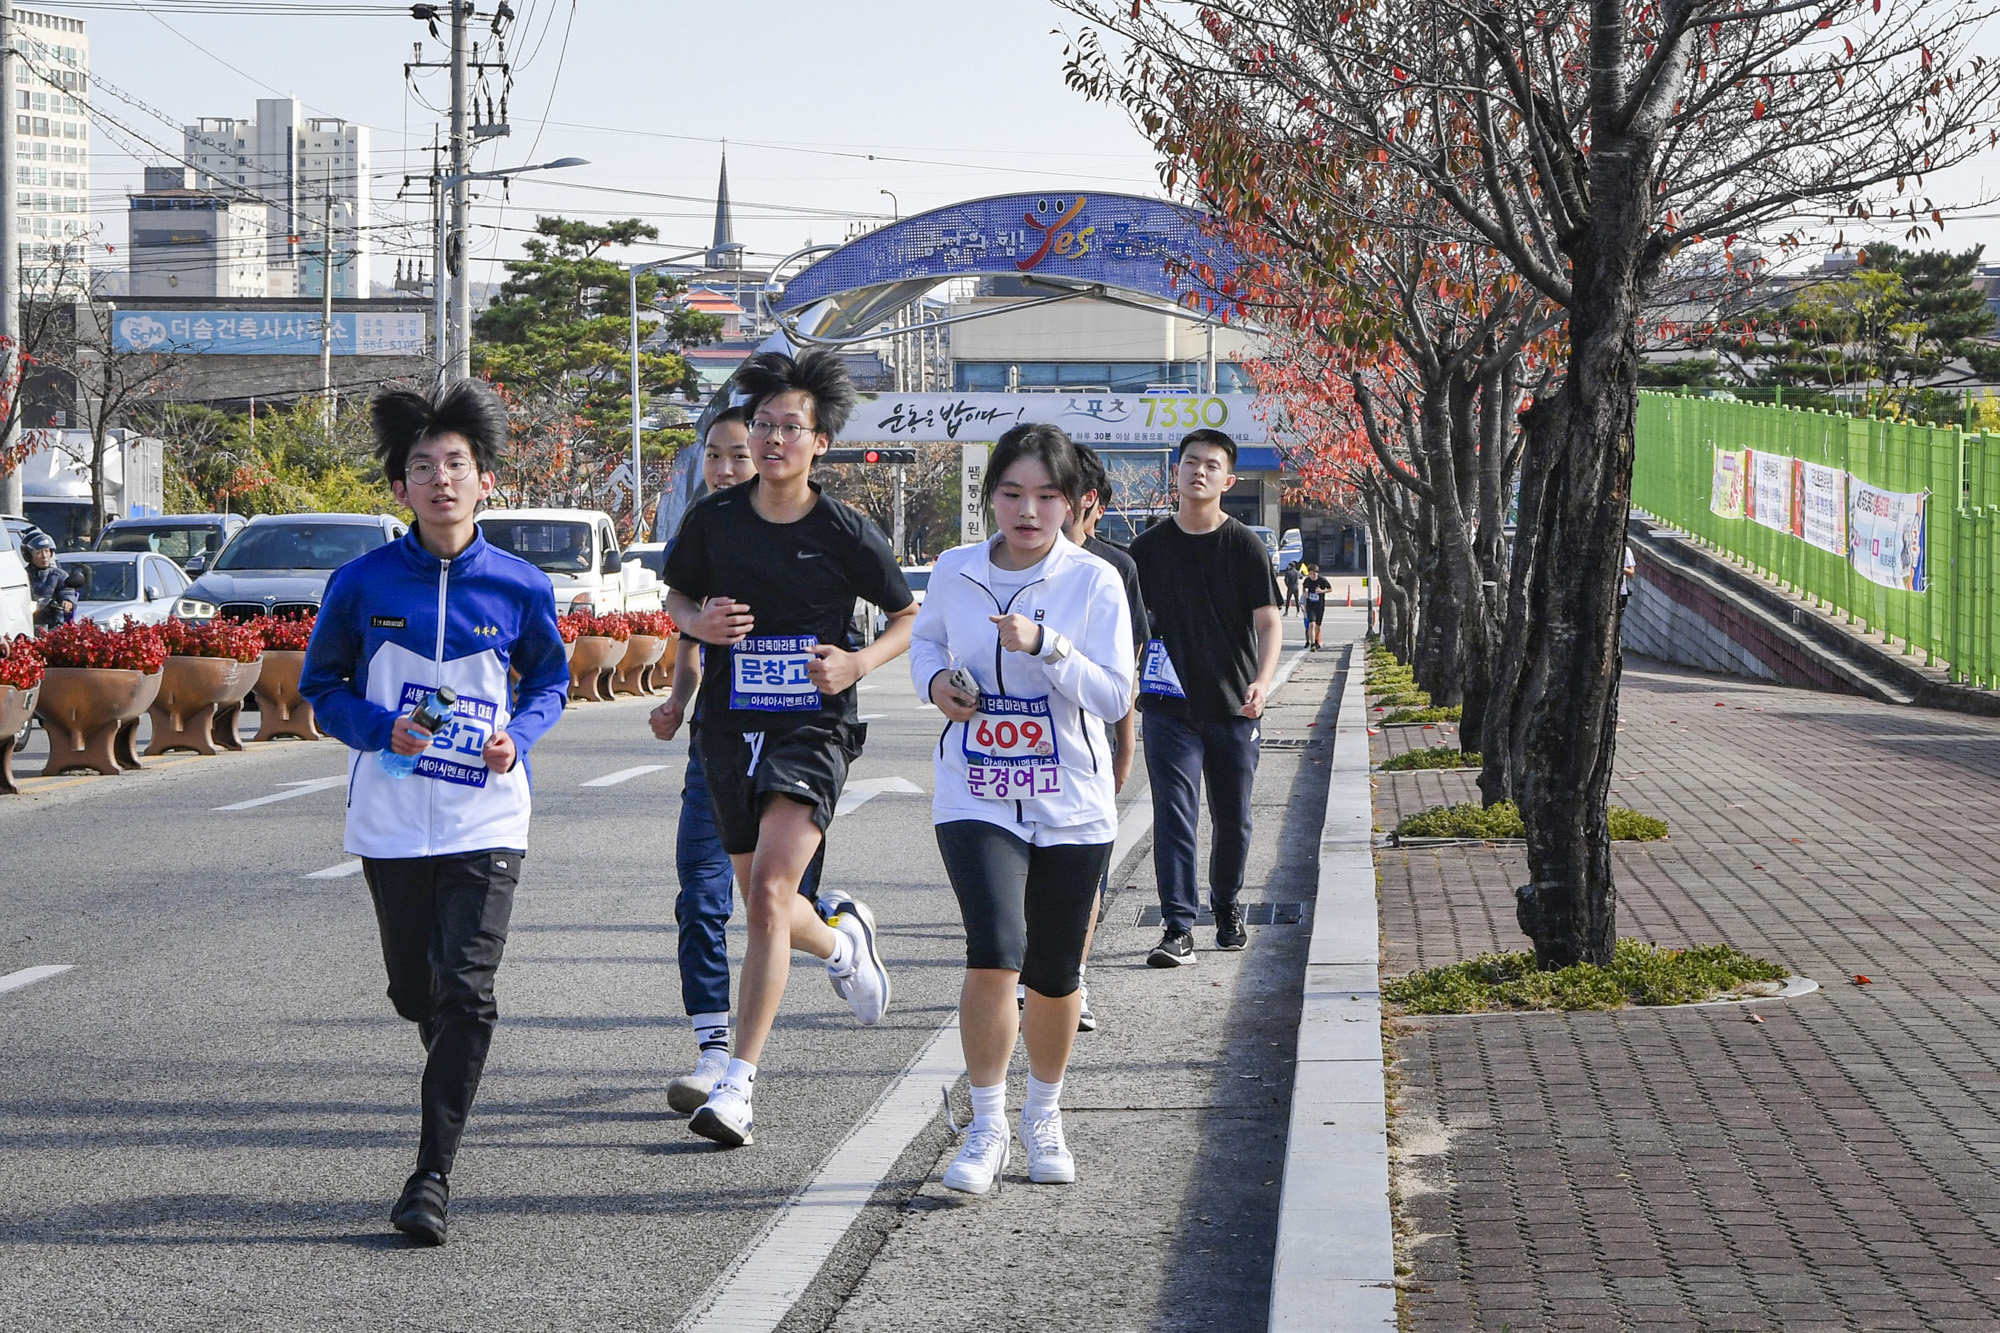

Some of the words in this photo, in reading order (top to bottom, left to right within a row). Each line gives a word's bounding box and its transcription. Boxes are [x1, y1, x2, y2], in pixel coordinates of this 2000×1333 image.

[1015, 196, 1095, 271] Yes
[878, 403, 935, 434] 운동은
[1063, 398, 1128, 417] 스포츠
[1139, 397, 1229, 429] 7330
[1094, 432, 1111, 440] 30분
[1116, 432, 1130, 440] 이상
[757, 639, 797, 652] 단축마라톤
[741, 659, 811, 685] 문창고
[478, 703, 494, 720] 대회
[751, 695, 819, 707] 아세아시멘트(주)
[987, 698, 1029, 713] 단축마라톤
[1030, 700, 1047, 714] 대회
[976, 720, 1043, 749] 609
[418, 759, 485, 784] 세아시멘트(주)
[967, 766, 1061, 798] 문경여고
